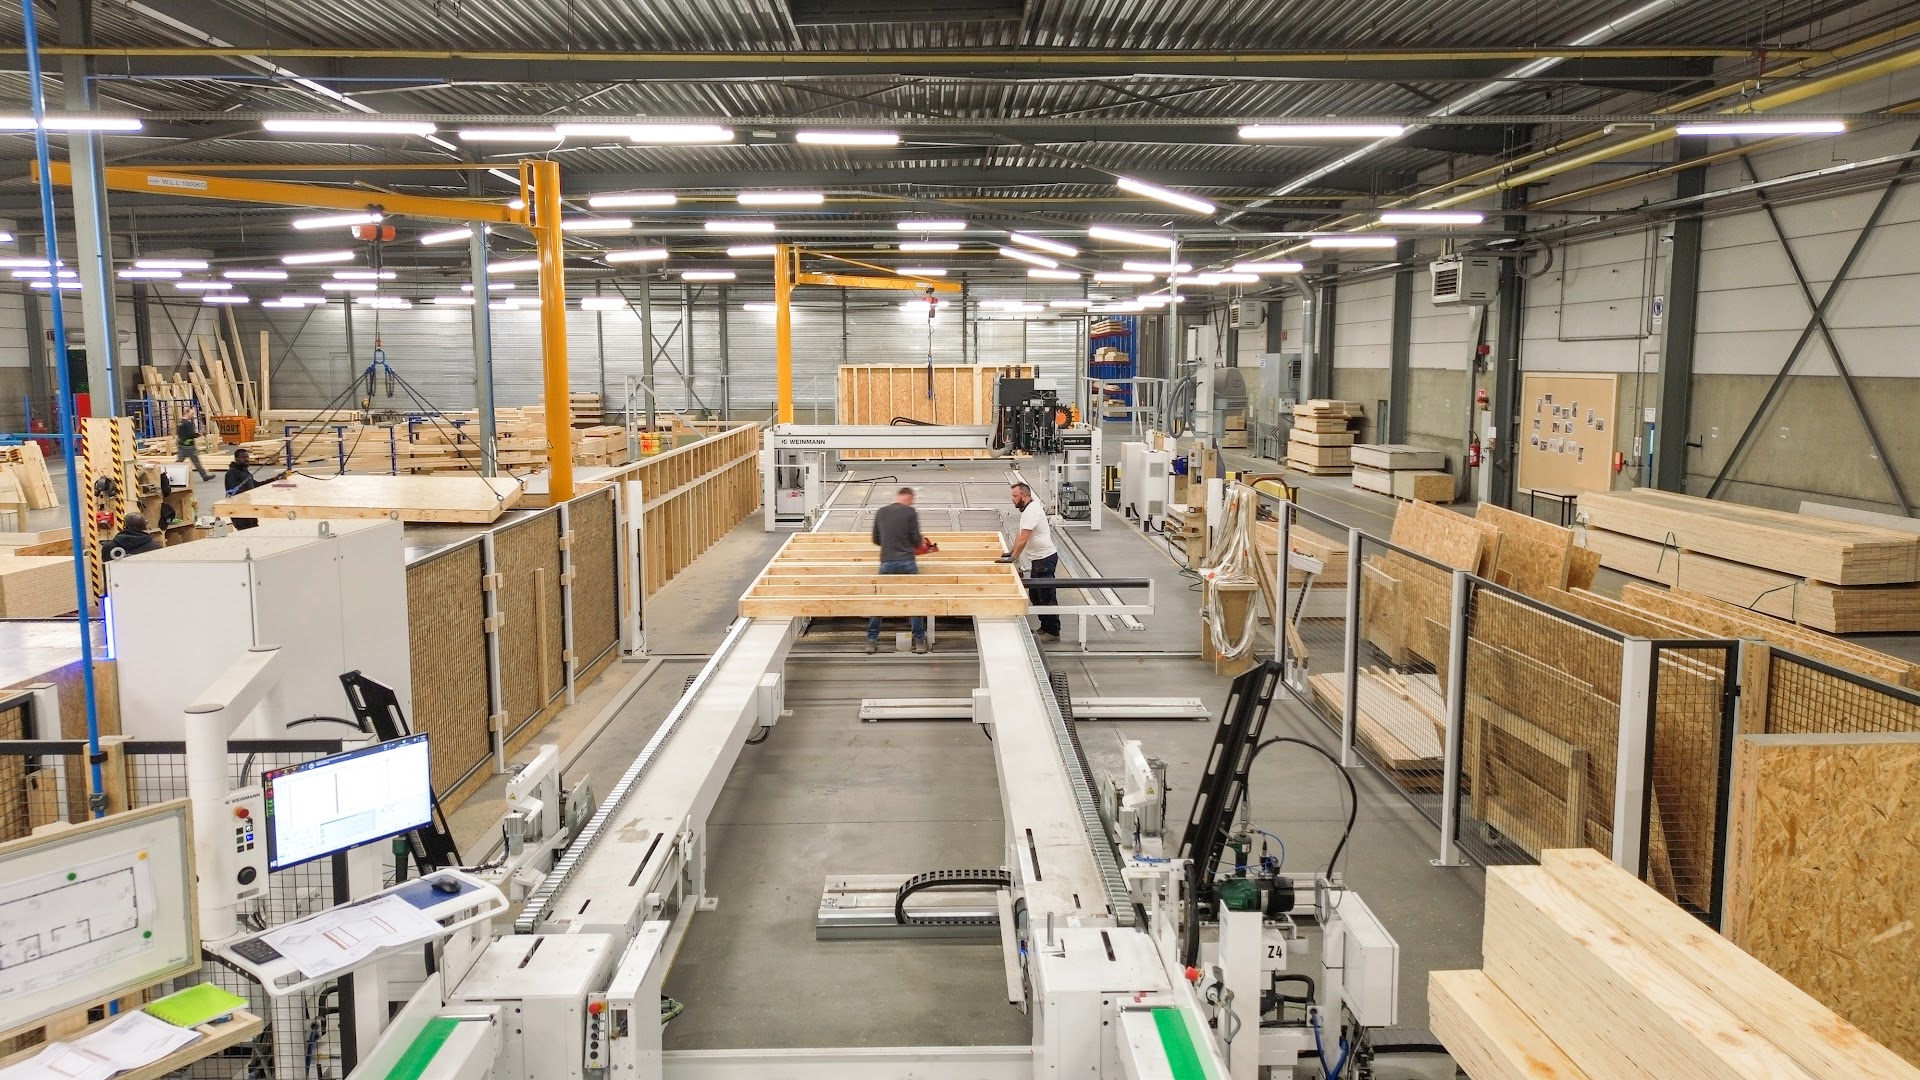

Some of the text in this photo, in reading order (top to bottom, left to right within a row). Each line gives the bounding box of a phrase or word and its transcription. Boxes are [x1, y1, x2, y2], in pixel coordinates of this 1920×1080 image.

[220, 424, 240, 432] HOUT
[231, 793, 261, 803] WEINMANN
[1267, 945, 1283, 959] Z4
